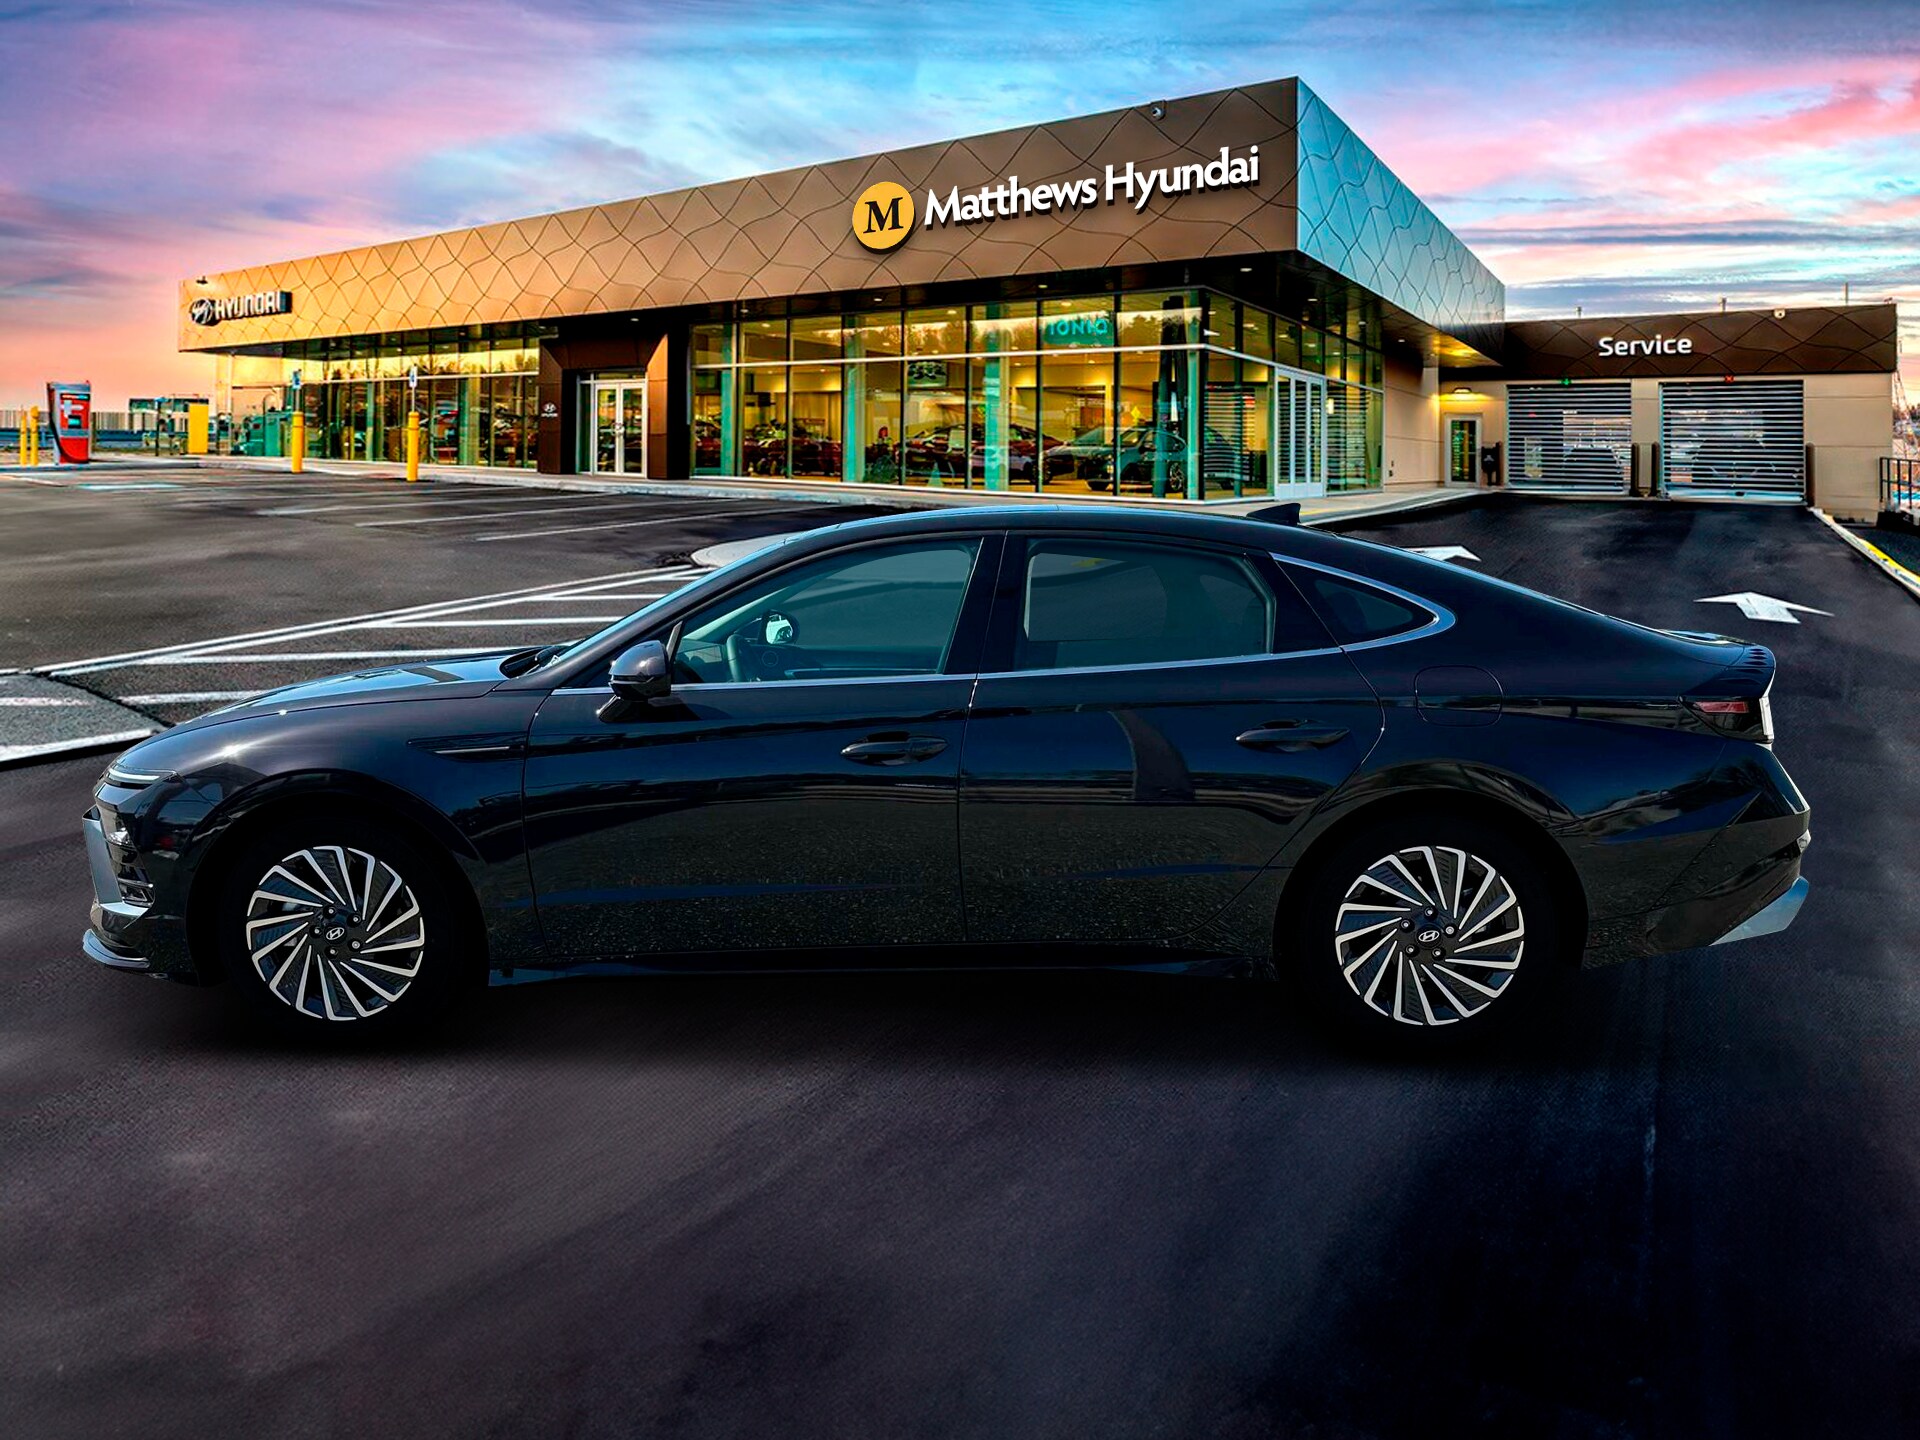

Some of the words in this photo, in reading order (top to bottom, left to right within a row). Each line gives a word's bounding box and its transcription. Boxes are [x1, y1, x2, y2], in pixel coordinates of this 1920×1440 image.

[863, 197, 904, 235] M
[924, 175, 1097, 226] Matthews
[1105, 145, 1260, 209] Hyundai
[214, 290, 281, 320] HYUNDAI
[1598, 334, 1693, 357] Service
